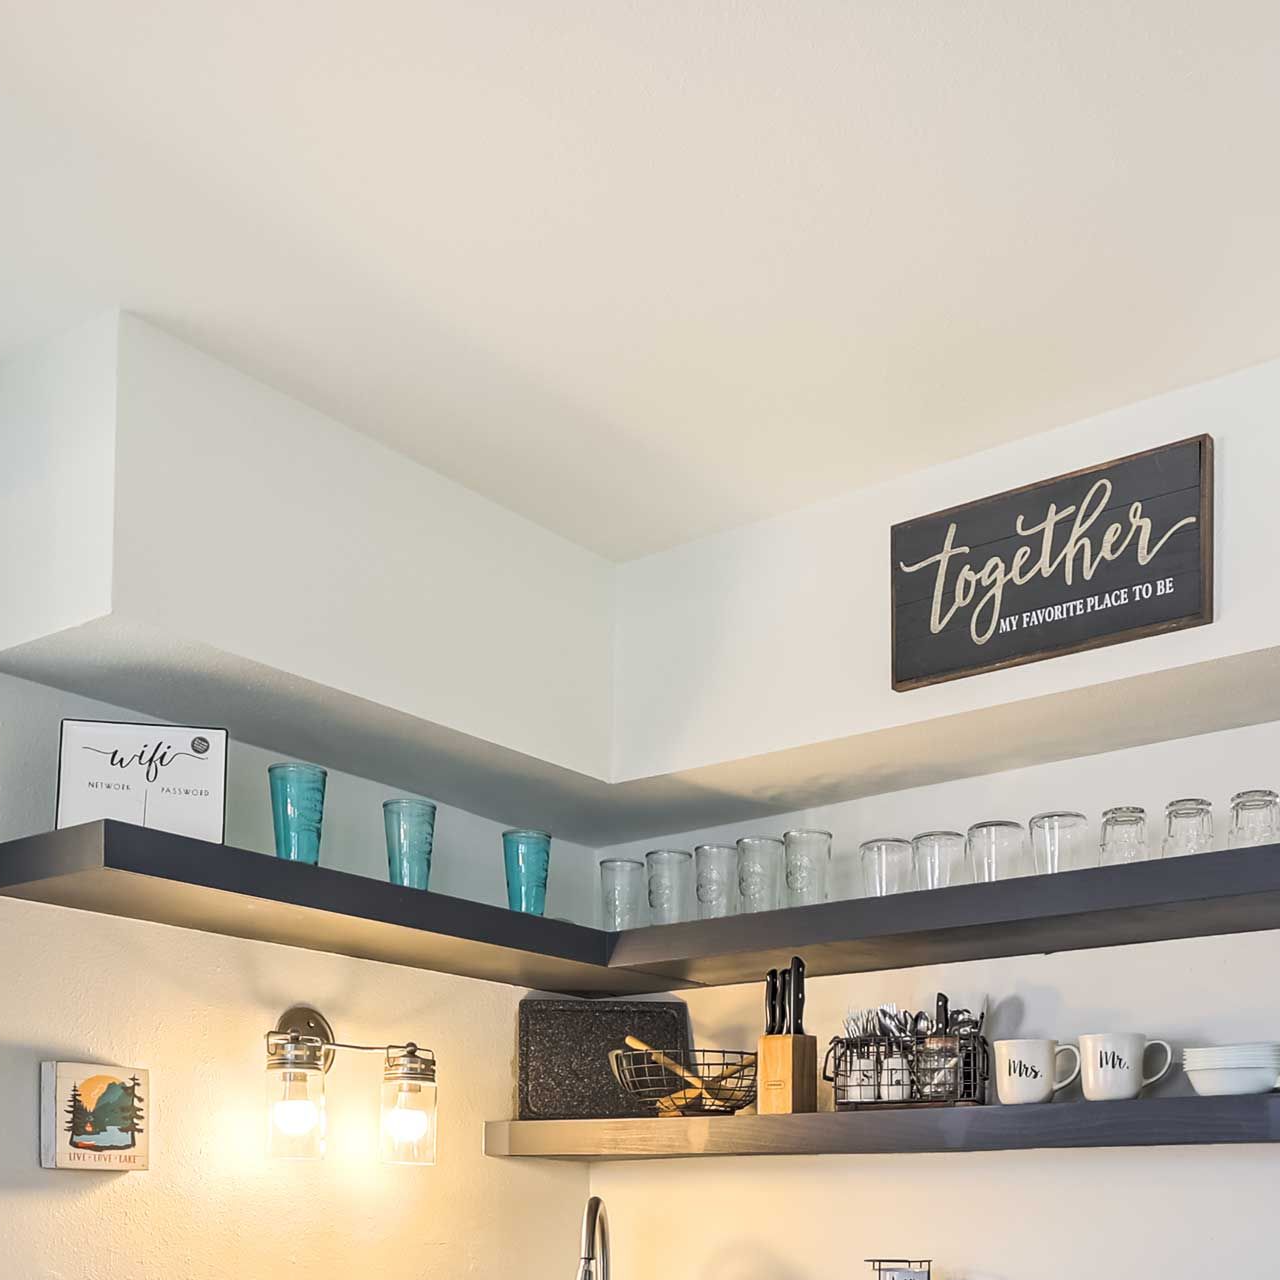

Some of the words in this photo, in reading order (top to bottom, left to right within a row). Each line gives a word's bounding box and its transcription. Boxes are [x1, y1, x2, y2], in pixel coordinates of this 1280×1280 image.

[899, 478, 1197, 645] together
[999, 616, 1018, 633] MY
[1022, 600, 1084, 629] FAVORITE
[1086, 588, 1128, 613] PLACE
[1132, 583, 1153, 601] TO
[1156, 577, 1175, 596] BE
[82, 741, 208, 782] wifi
[87, 781, 132, 791] NETWORK
[160, 787, 210, 797] PASSWORD
[1008, 1058, 1043, 1079] Mrs.
[1098, 1049, 1130, 1070] Mr.
